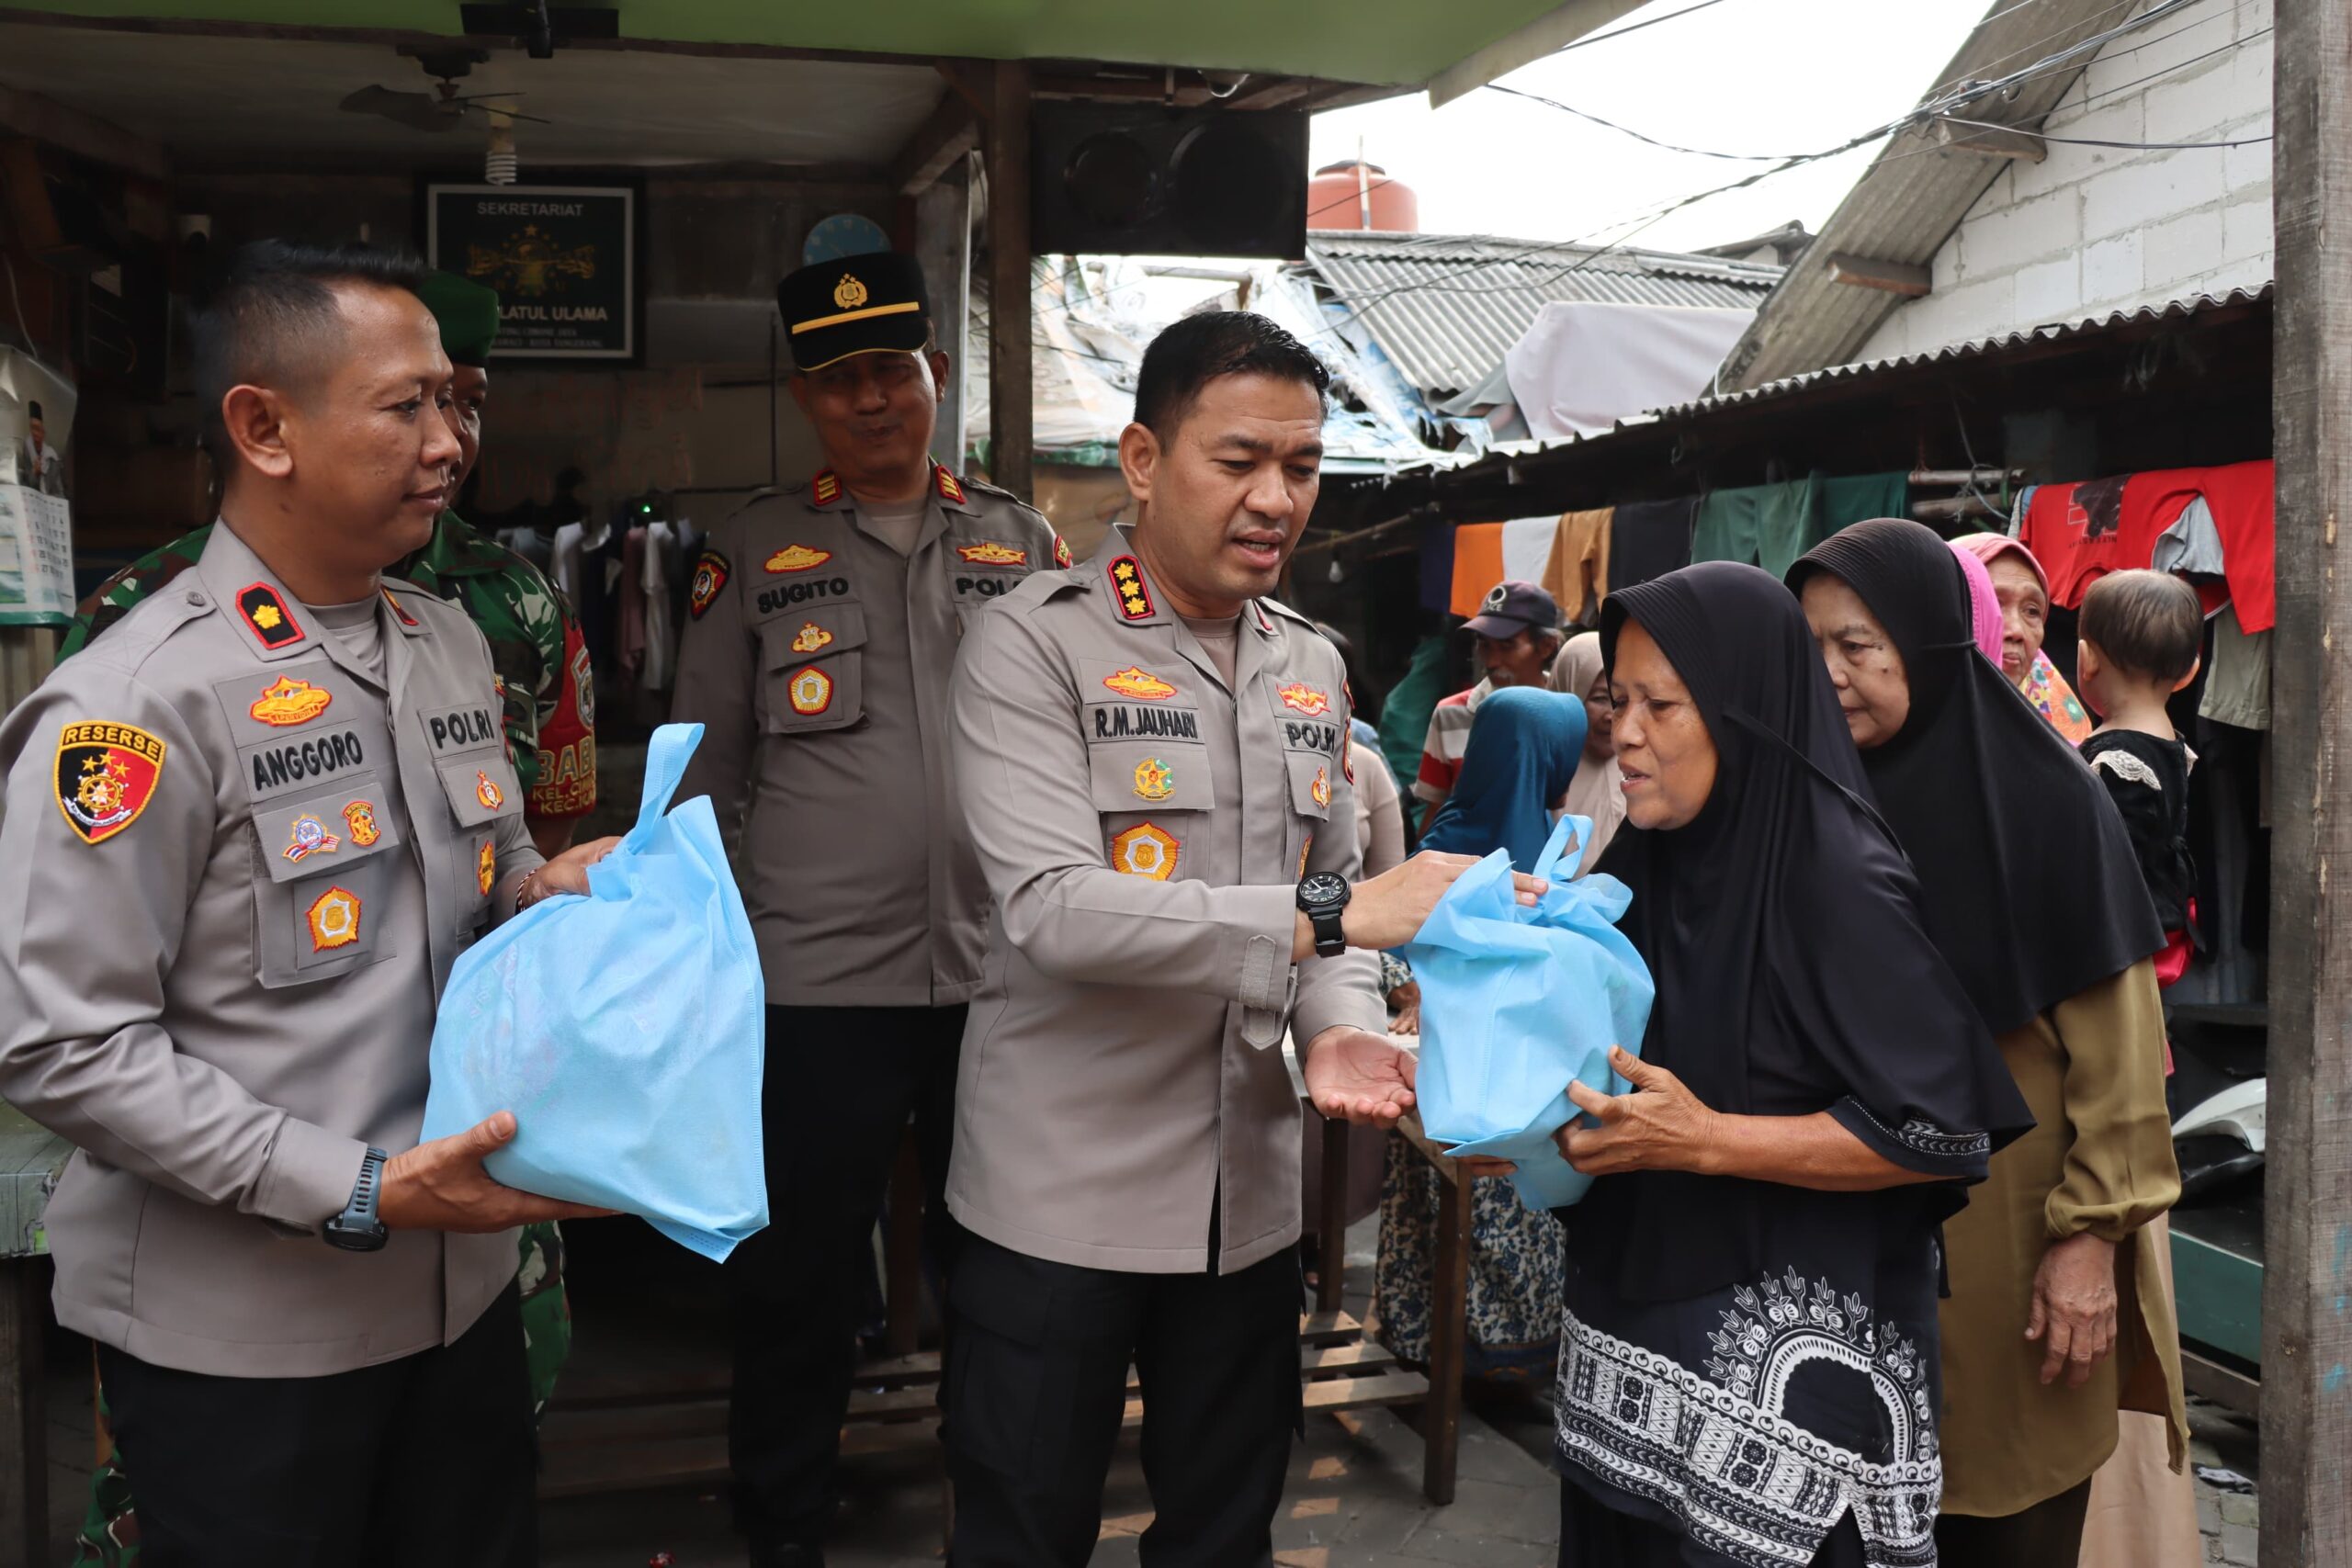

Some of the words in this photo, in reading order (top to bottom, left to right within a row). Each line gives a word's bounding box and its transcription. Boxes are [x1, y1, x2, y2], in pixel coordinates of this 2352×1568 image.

[477, 202, 583, 217] SEKRETARIAT
[499, 306, 548, 321] LATUL
[552, 306, 608, 321] ULAMA
[757, 577, 849, 615] SUGITO
[956, 577, 1023, 597] POL
[430, 709, 495, 750] POLRI
[1095, 705, 1198, 739] R.M.JAUHARI
[64, 725, 160, 760] RESERSE
[253, 730, 363, 792] ANGGORO
